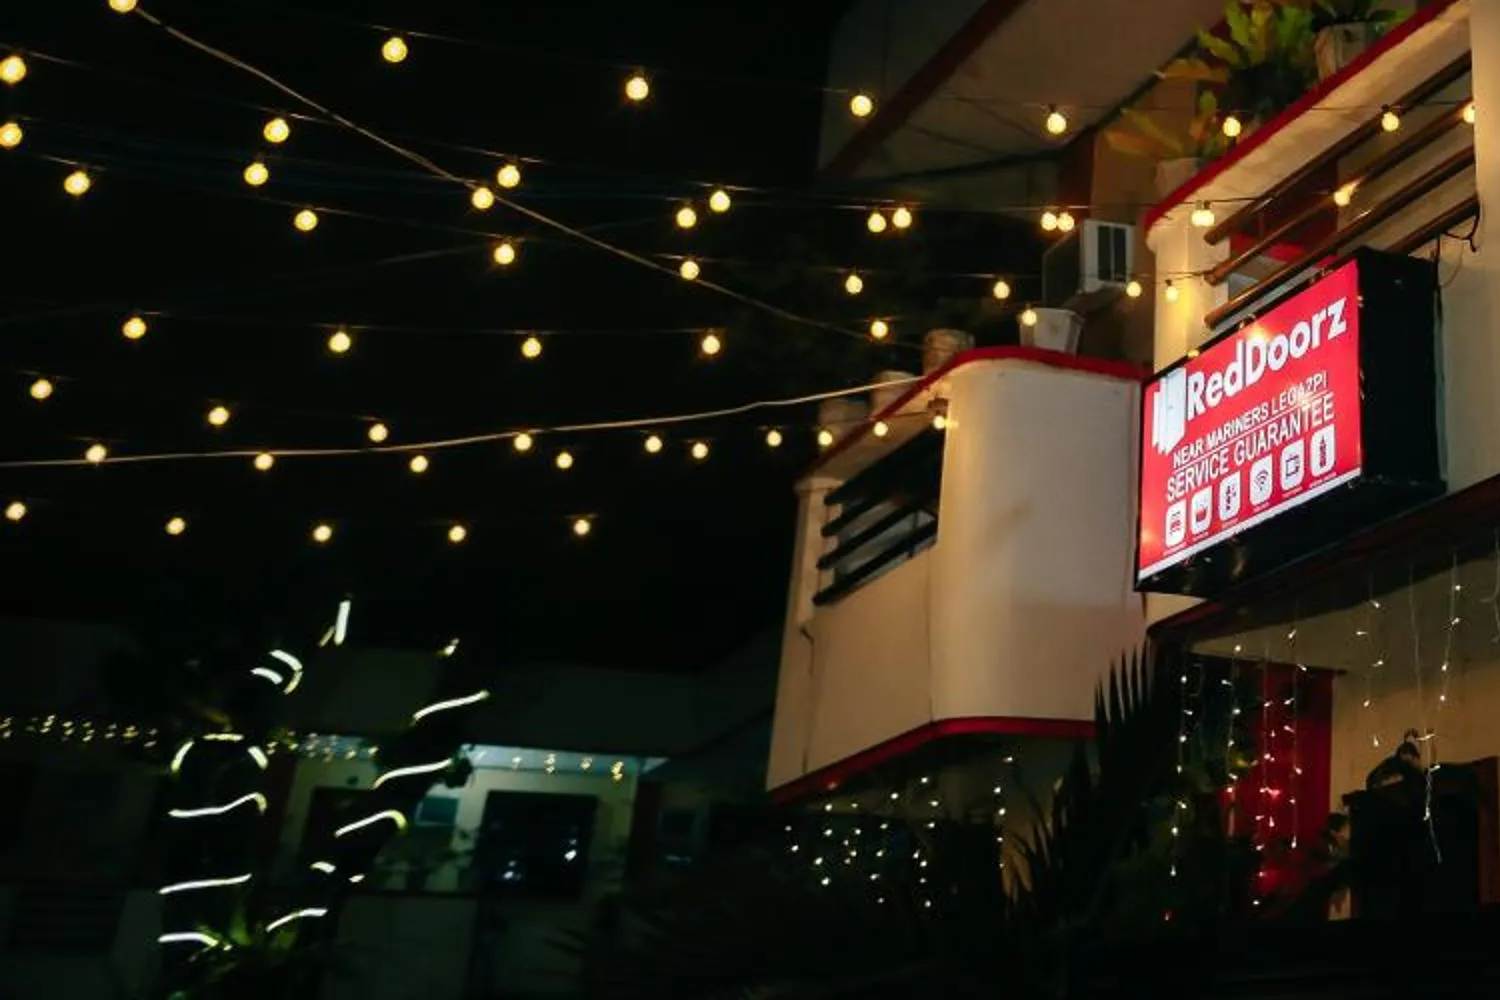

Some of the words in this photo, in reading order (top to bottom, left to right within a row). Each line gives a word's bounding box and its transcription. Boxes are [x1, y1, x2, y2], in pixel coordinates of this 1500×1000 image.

[1187, 296, 1348, 421] RedDoorz
[1166, 447, 1230, 501] SERVICE
[1233, 392, 1335, 467] GUARANTEE
[1172, 438, 1204, 469] NEAR
[1206, 402, 1269, 449] MARINERS
[1271, 370, 1328, 414] LEGAZPI
